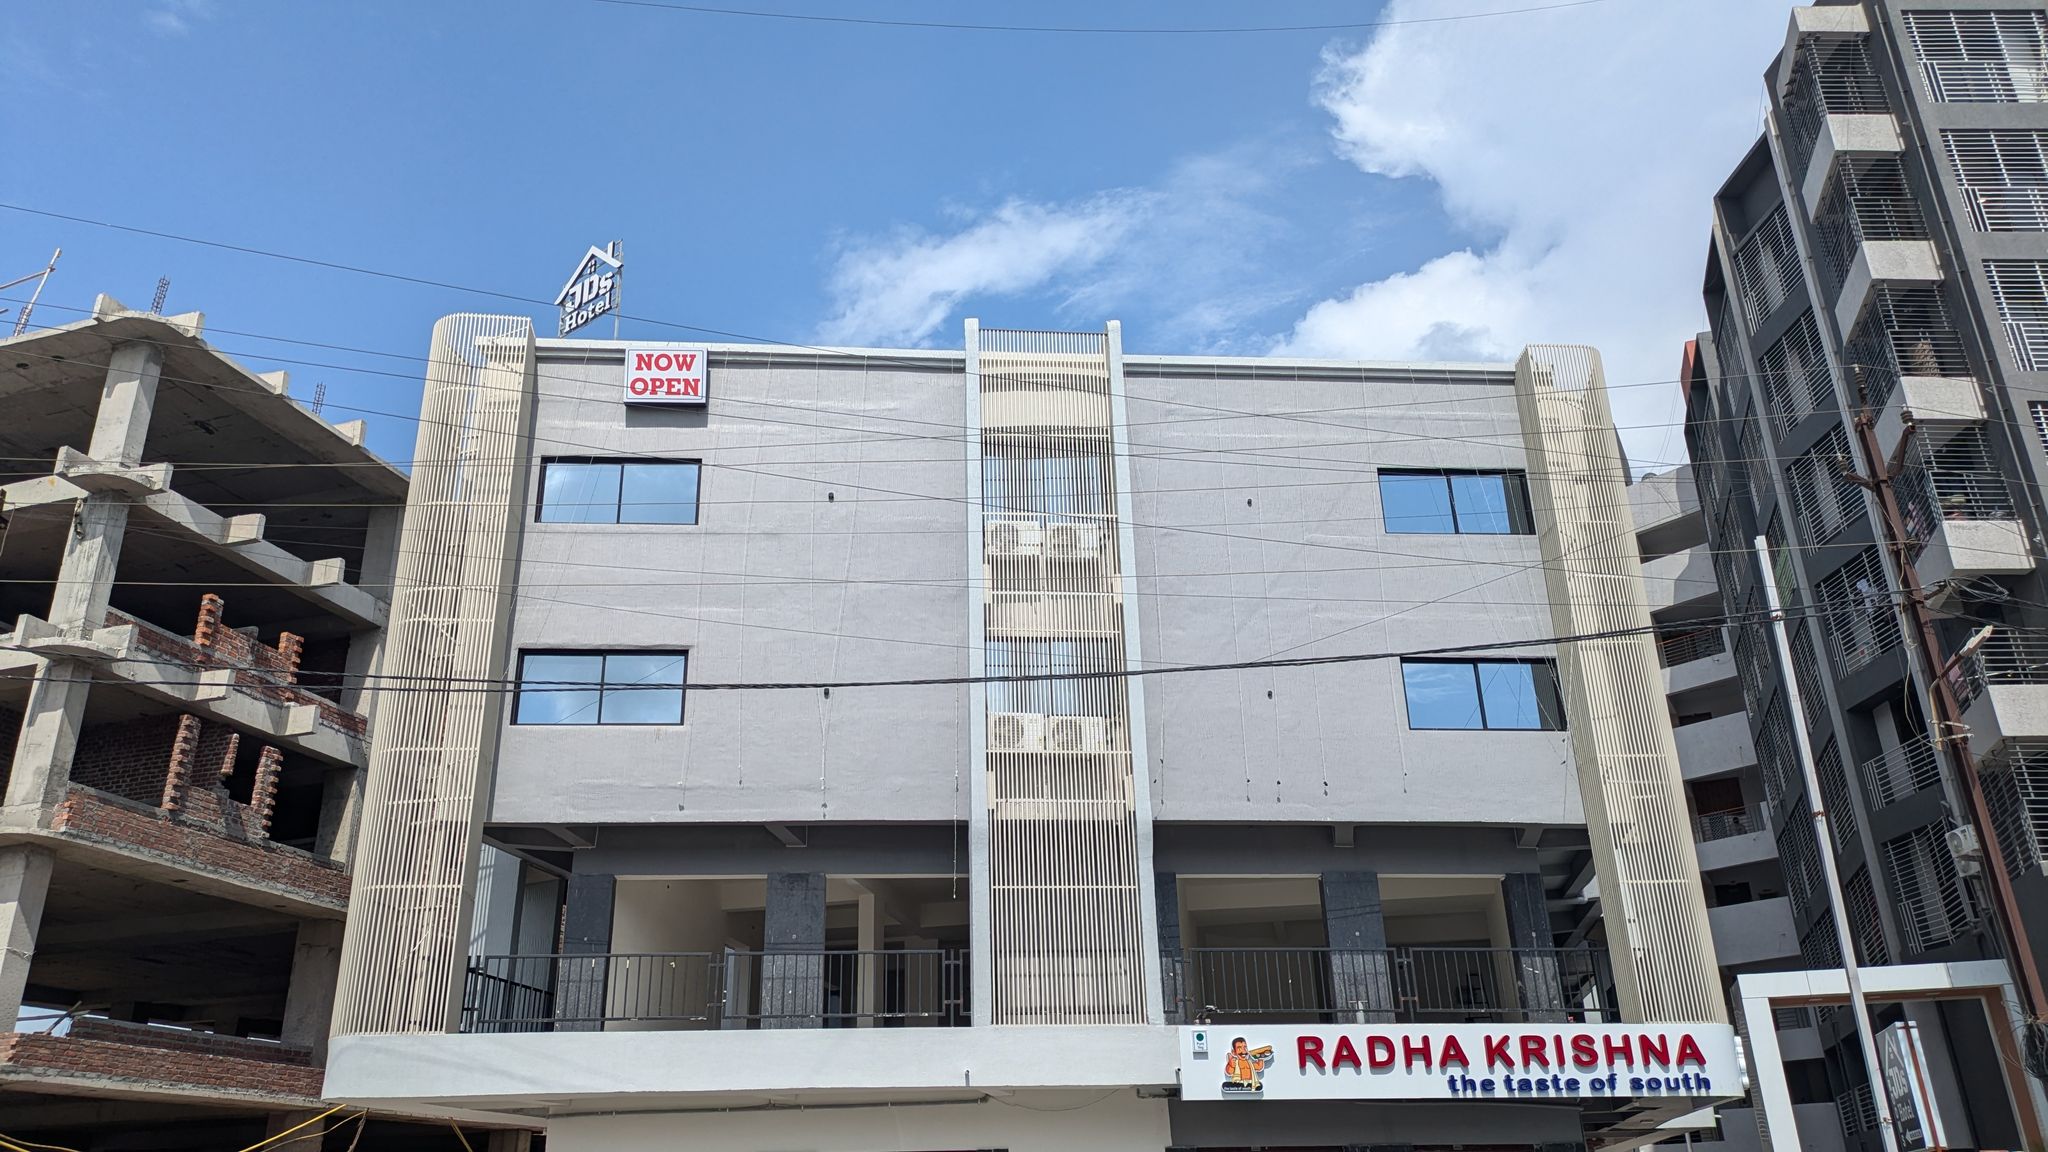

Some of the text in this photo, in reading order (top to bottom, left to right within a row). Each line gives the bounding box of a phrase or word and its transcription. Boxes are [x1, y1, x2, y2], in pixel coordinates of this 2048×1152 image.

[562, 291, 612, 333] Hotel
[635, 353, 697, 372] NOW
[630, 377, 701, 396] OPEN
[1296, 1033, 1707, 1069] RADHA KRISHNA
[1447, 1072, 1711, 1093] the taste of south
